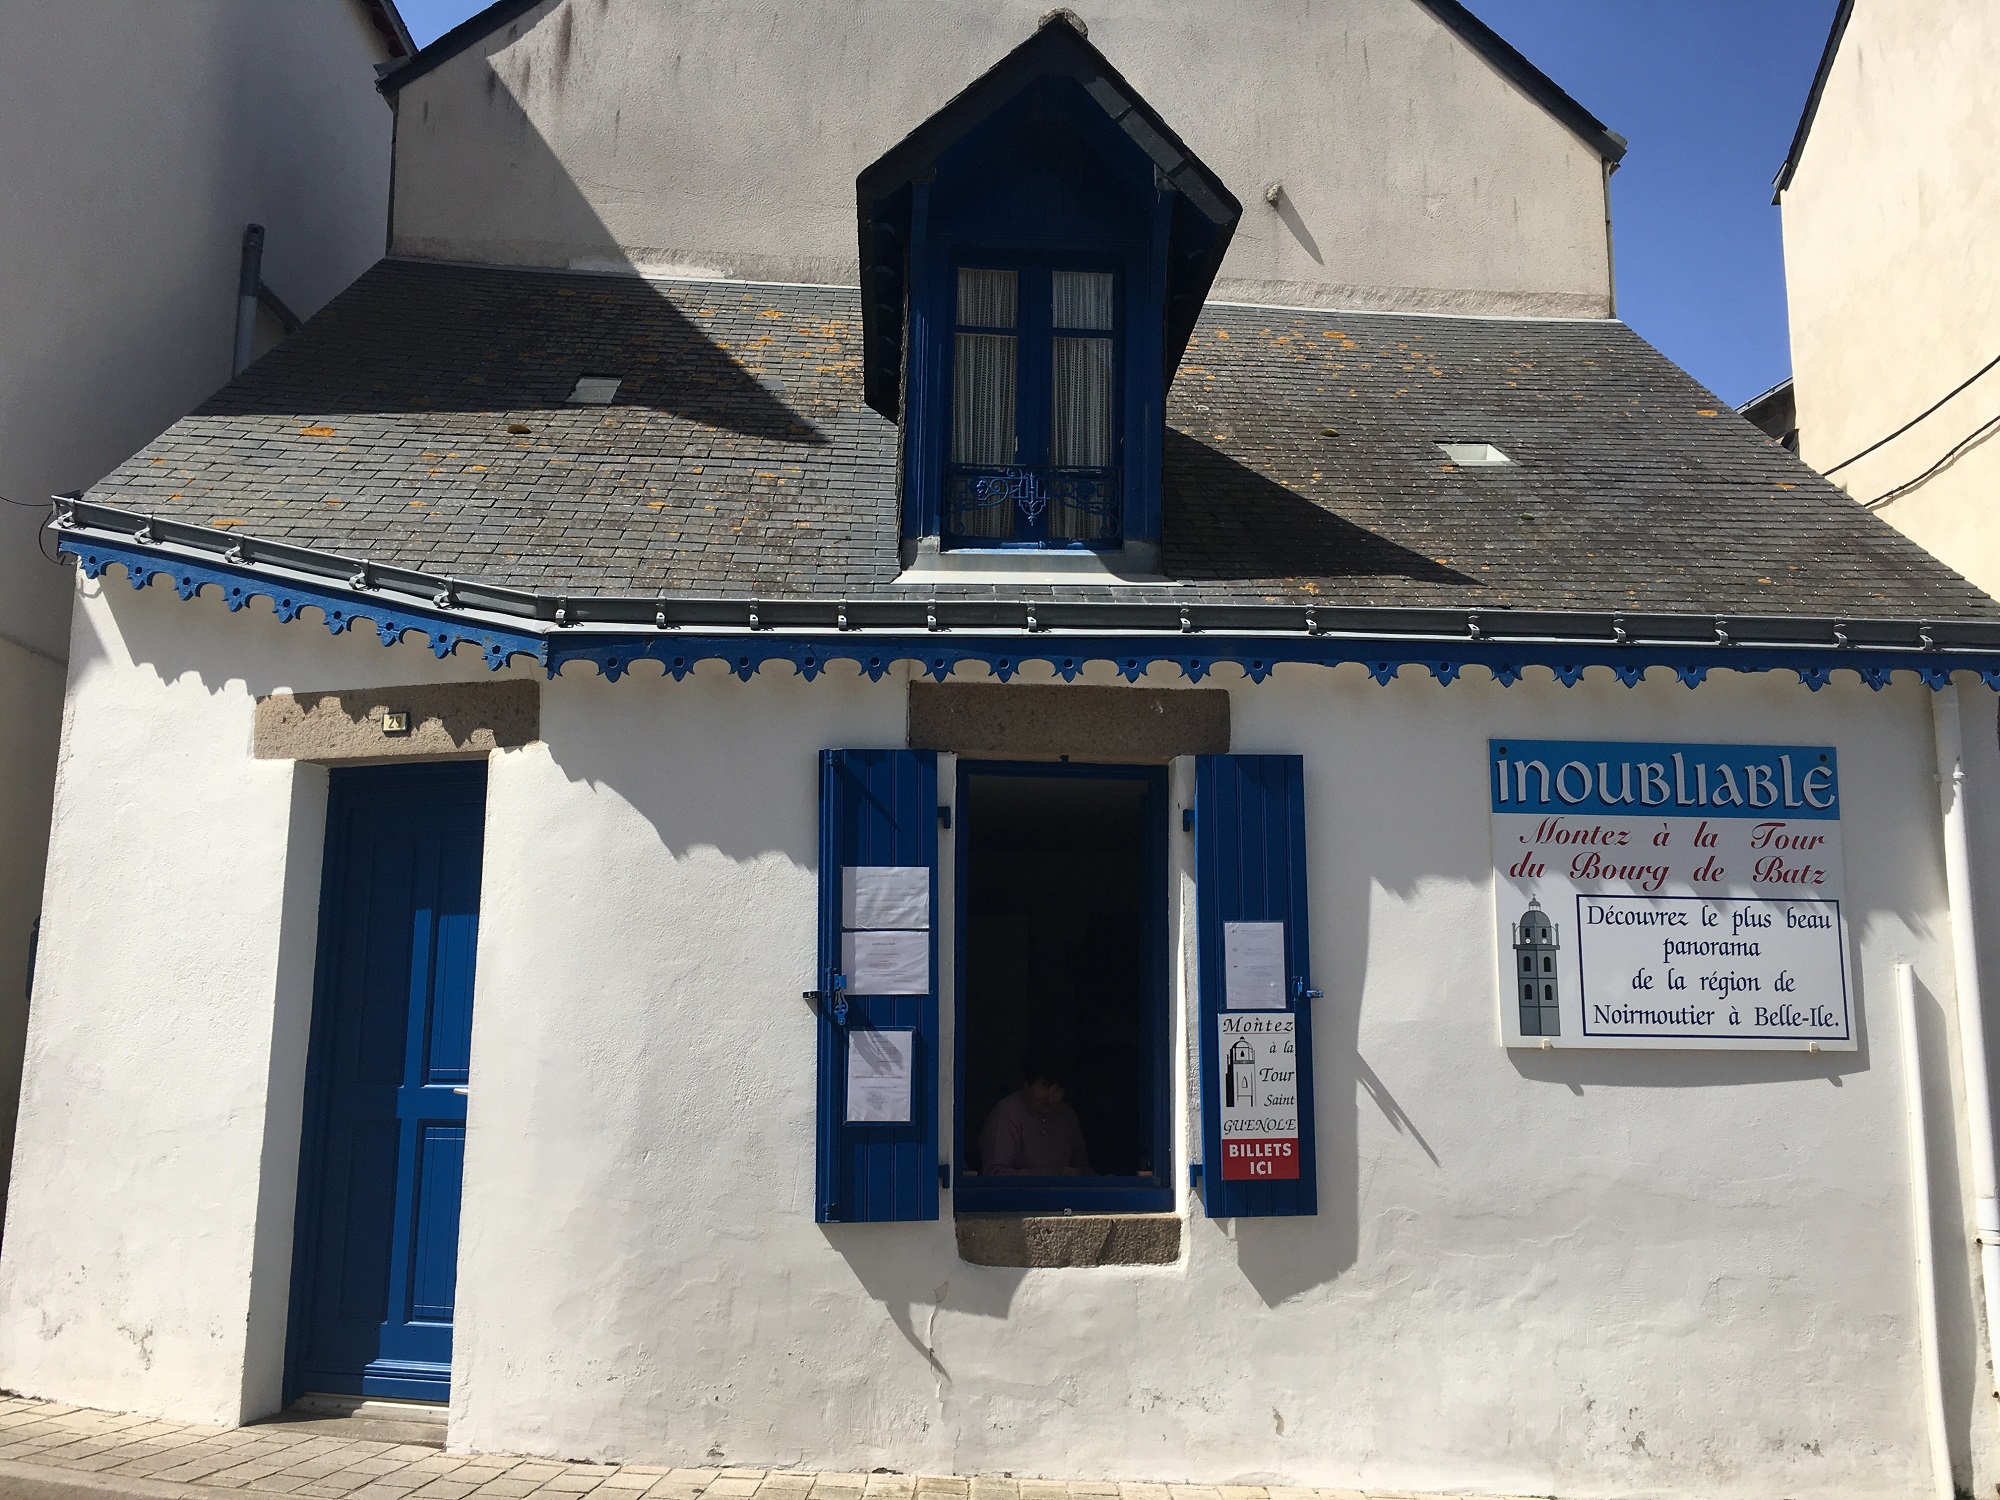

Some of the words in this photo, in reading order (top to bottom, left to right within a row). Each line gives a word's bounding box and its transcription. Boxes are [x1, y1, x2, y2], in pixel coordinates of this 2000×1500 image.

[1519, 816, 1632, 846] Montez
[1653, 822, 1671, 847] à
[1693, 821, 1719, 848] la
[1751, 822, 1825, 850] Tour
[1509, 851, 1548, 878] du
[1569, 851, 1670, 892] Bourg
[1692, 855, 1728, 882] de
[1752, 855, 1829, 885] Batz
[1587, 905, 1689, 926] Découvrez
[1701, 904, 1719, 927] le
[1732, 905, 1772, 936] plus
[1786, 906, 1832, 929] beau
[1663, 937, 1762, 964] panorama
[1631, 967, 1654, 990] de
[1667, 967, 1687, 990] la
[1699, 970, 1761, 1000] région
[1774, 969, 1796, 992] de
[1223, 1016, 1293, 1032] Montez
[1593, 1003, 1715, 1026] Noirmoutier
[1728, 1005, 1742, 1026] à
[1754, 1003, 1840, 1027] Belle-Ile.
[1269, 1041, 1277, 1053] à
[1283, 1040, 1294, 1053] la
[1259, 1067, 1295, 1082] Tour
[1264, 1093, 1295, 1107] Saint
[1223, 1117, 1296, 1135] GUENOLE
[1229, 1143, 1292, 1157] BILLETS
[1250, 1161, 1272, 1175] ICI
